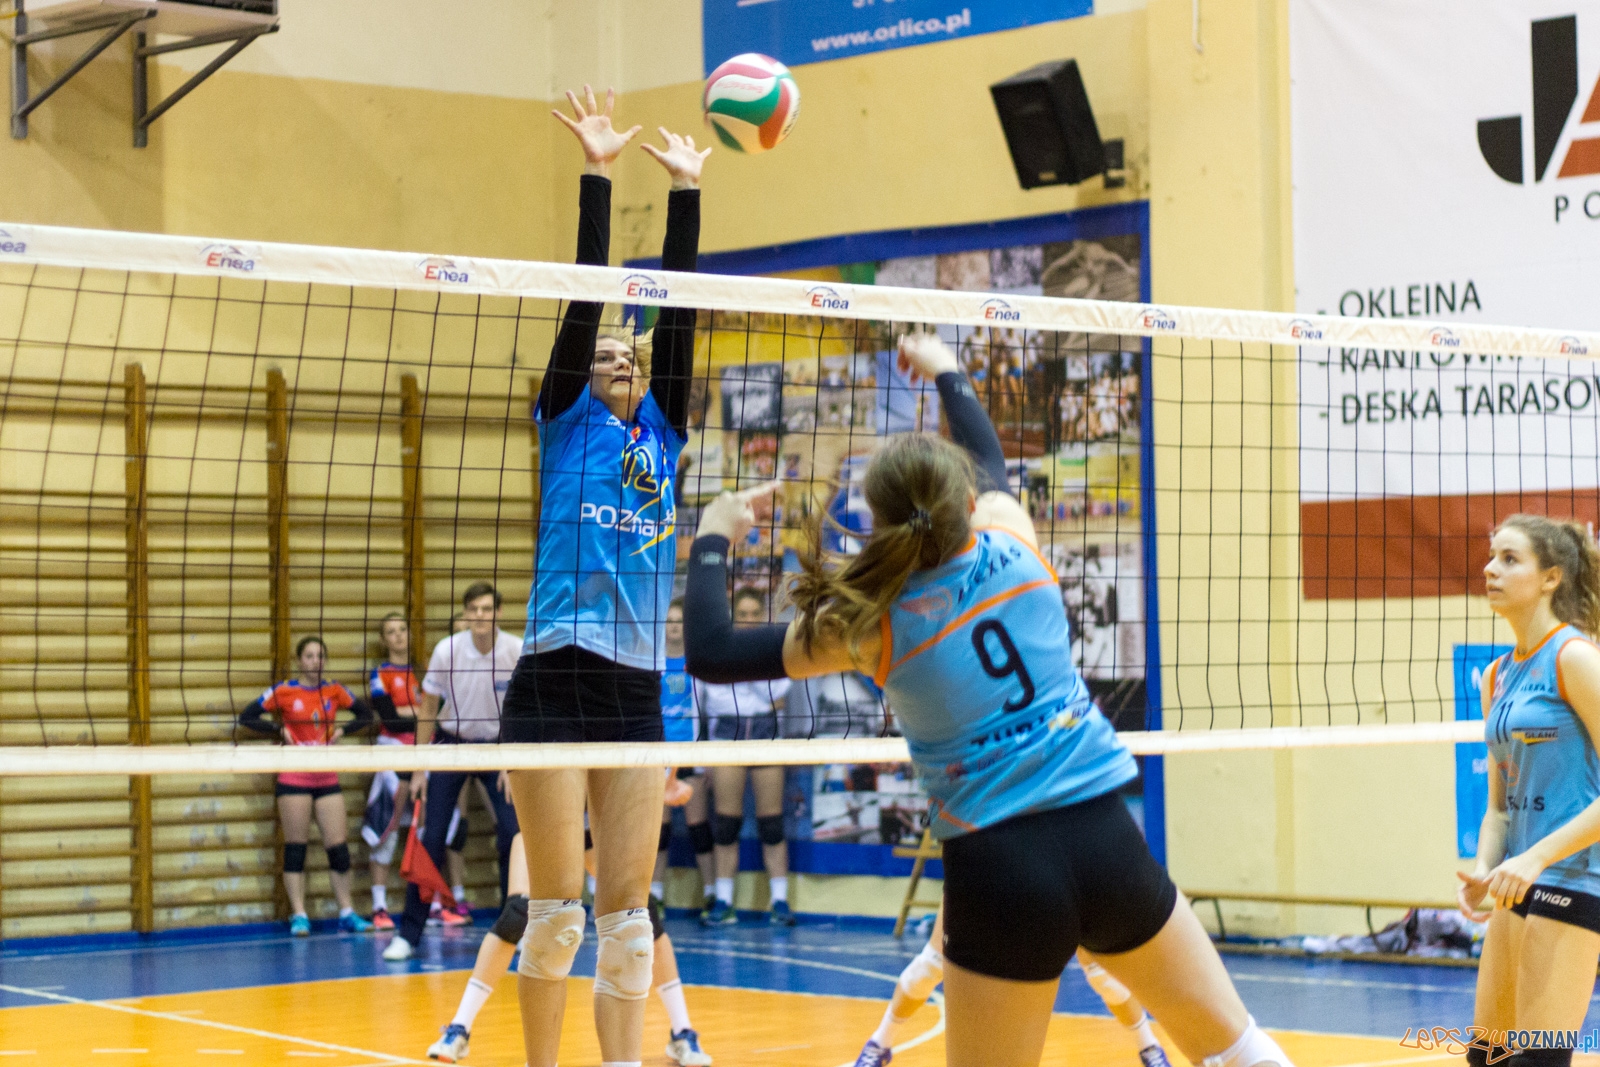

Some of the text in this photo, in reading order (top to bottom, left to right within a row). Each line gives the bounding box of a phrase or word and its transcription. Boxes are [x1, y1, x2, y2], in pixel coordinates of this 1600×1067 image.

[810, 8, 971, 51] www.orlico.pl
[206, 252, 255, 270] Enea
[424, 265, 469, 283] Enea
[626, 282, 668, 300] Enea
[1339, 280, 1482, 317] OKLEINA
[810, 293, 850, 310] Enea
[984, 306, 1021, 321] Enea
[1143, 315, 1176, 330] Enea
[1291, 325, 1323, 340] Enea
[1342, 388, 1443, 424] DESKA
[1455, 376, 1600, 416] TARASO
[622, 440, 658, 493] 12
[971, 618, 1035, 713] 9
[1496, 700, 1514, 745] 11
